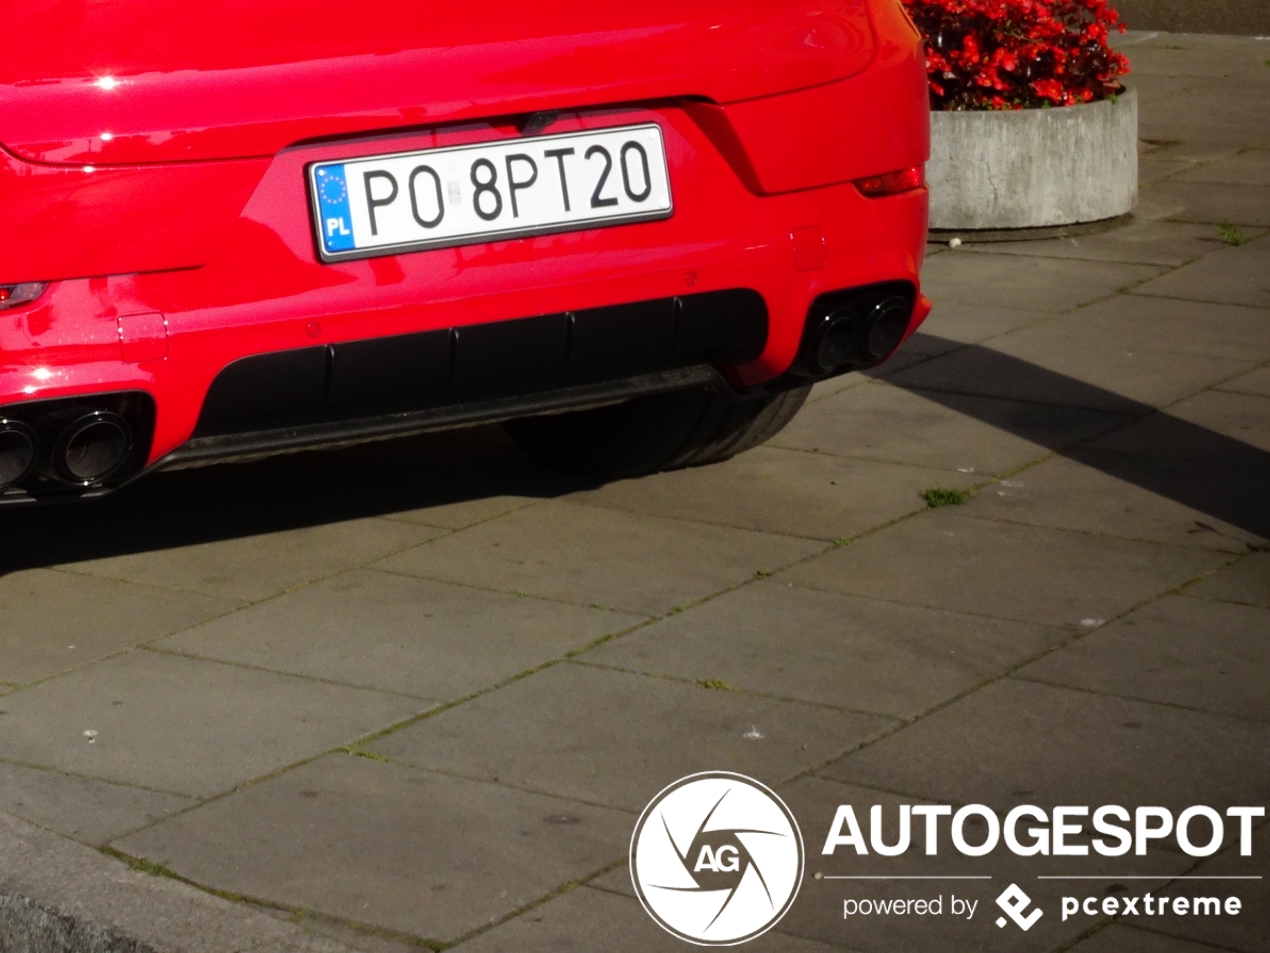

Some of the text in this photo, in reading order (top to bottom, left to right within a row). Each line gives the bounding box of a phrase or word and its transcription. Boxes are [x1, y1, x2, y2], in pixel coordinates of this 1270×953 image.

[363, 140, 652, 236] PO 8PT20
[327, 218, 350, 236] PL
